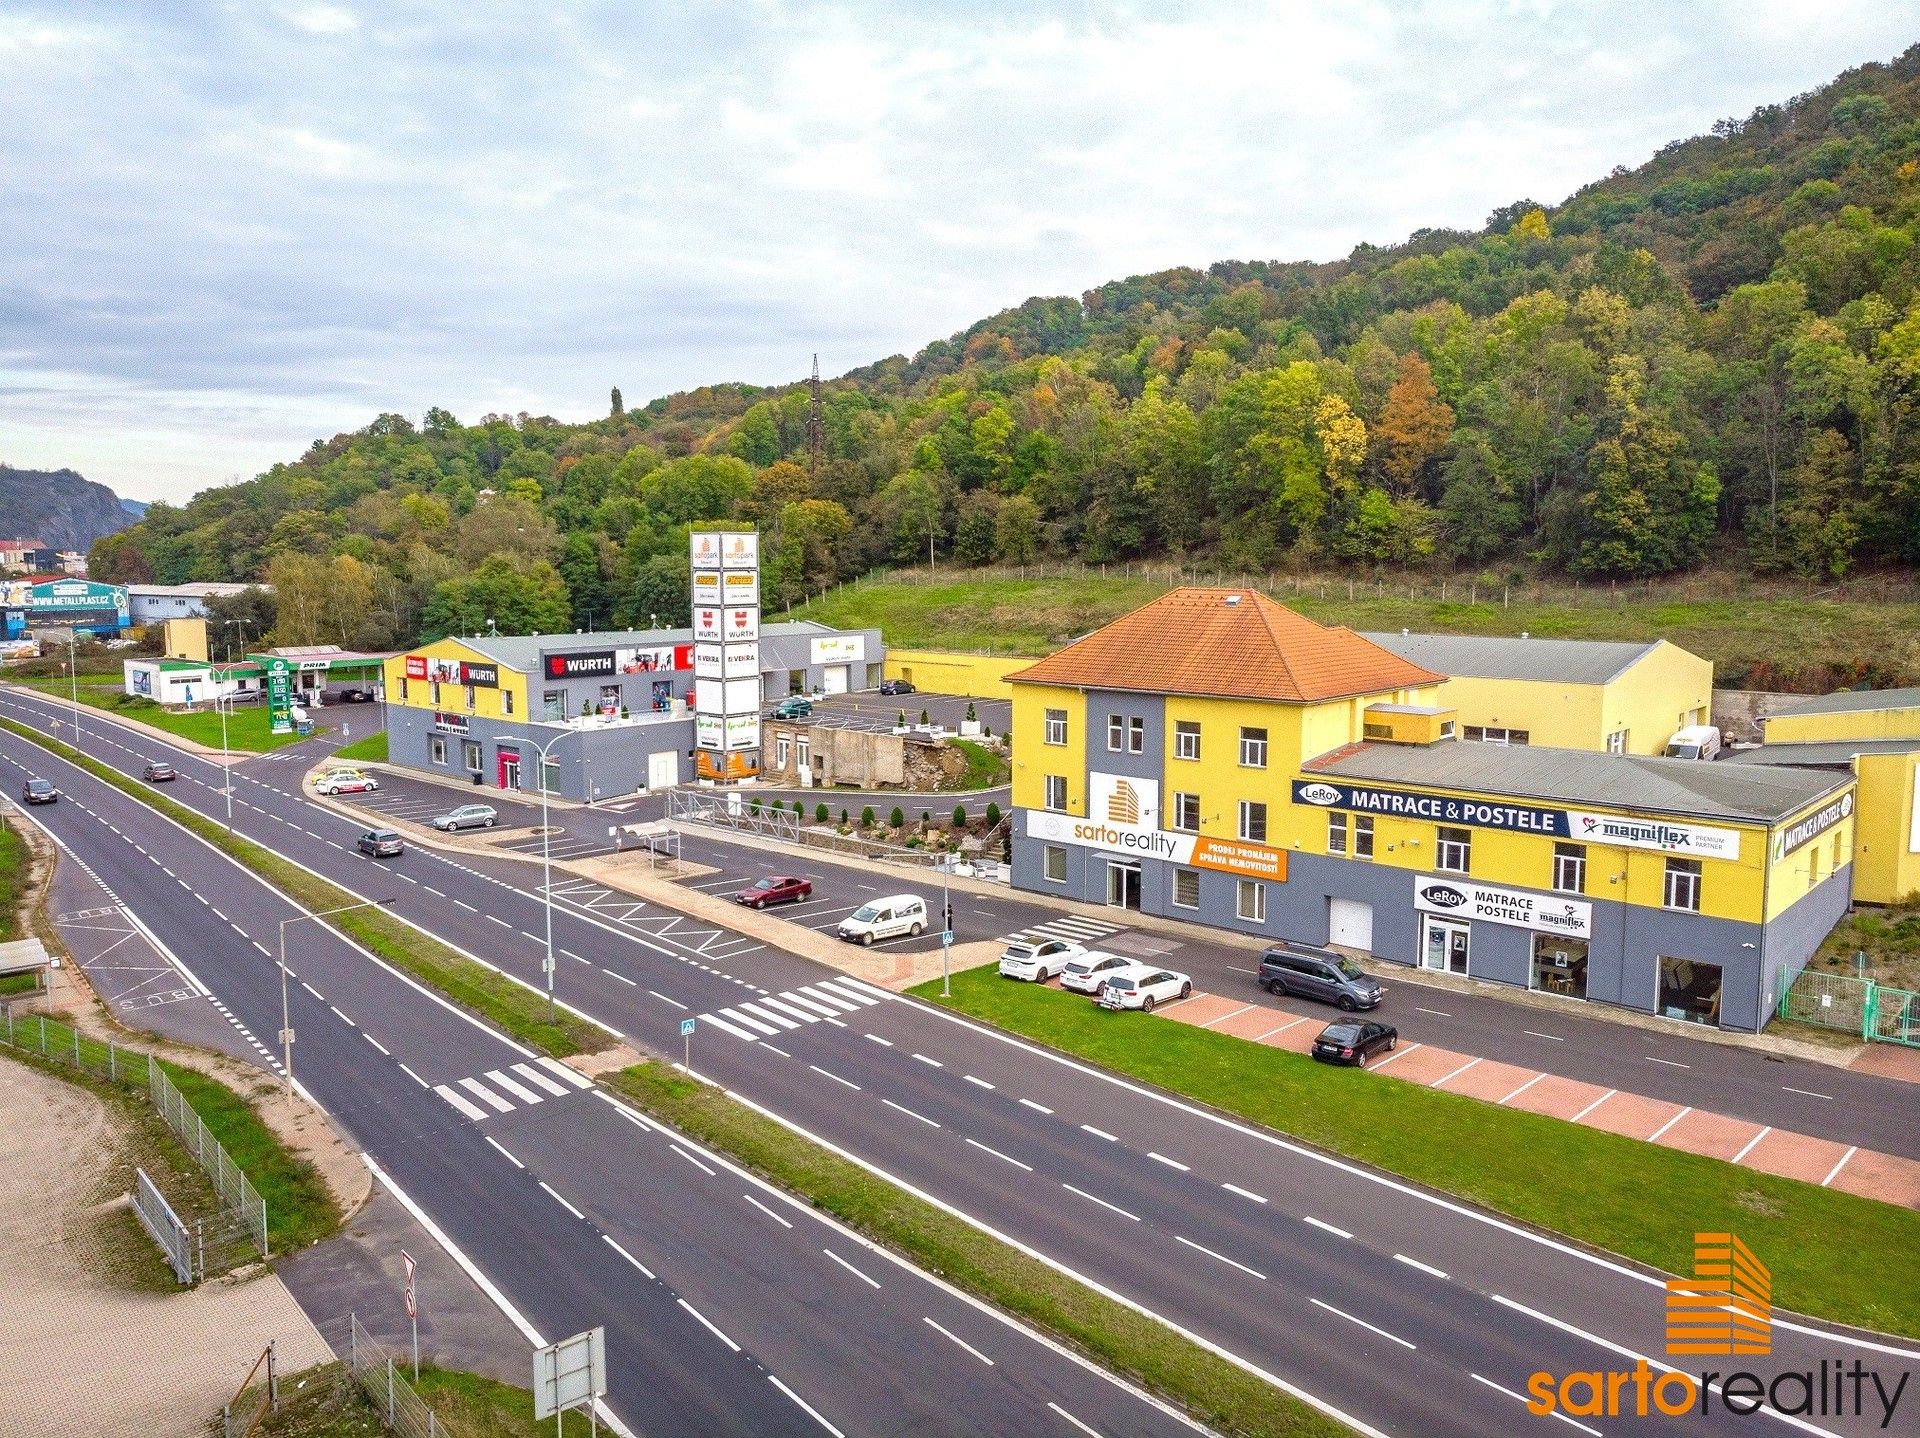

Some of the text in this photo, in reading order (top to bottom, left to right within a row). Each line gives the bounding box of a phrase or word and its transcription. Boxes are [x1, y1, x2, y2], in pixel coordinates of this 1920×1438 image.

[32, 595, 110, 607] WWW.METALLPLAST.CZ
[566, 657, 612, 672] WÜRTH
[468, 667, 496, 682] WÜRTH
[1305, 787, 1555, 831] LeRoy MATRACE & POSTELE
[1603, 822, 1691, 846] magniflex
[1784, 819, 1813, 852] MATRACE
[1817, 802, 1841, 830] POSTELE
[1074, 824, 1177, 858] sartoreality
[1695, 835, 1725, 844] PREMIUM
[1695, 841, 1723, 850] PARTNER
[1208, 843, 1279, 862] PRODEJ PRONÁJEM
[1199, 852, 1278, 873] SPRÁVA NEMOVITOSTÍ
[1427, 889, 1466, 906] LeRoy
[1475, 891, 1534, 910] MATRACE
[1476, 904, 1530, 923] POSTELE
[1539, 912, 1586, 929] magniflex
[120, 990, 189, 1010] BUS
